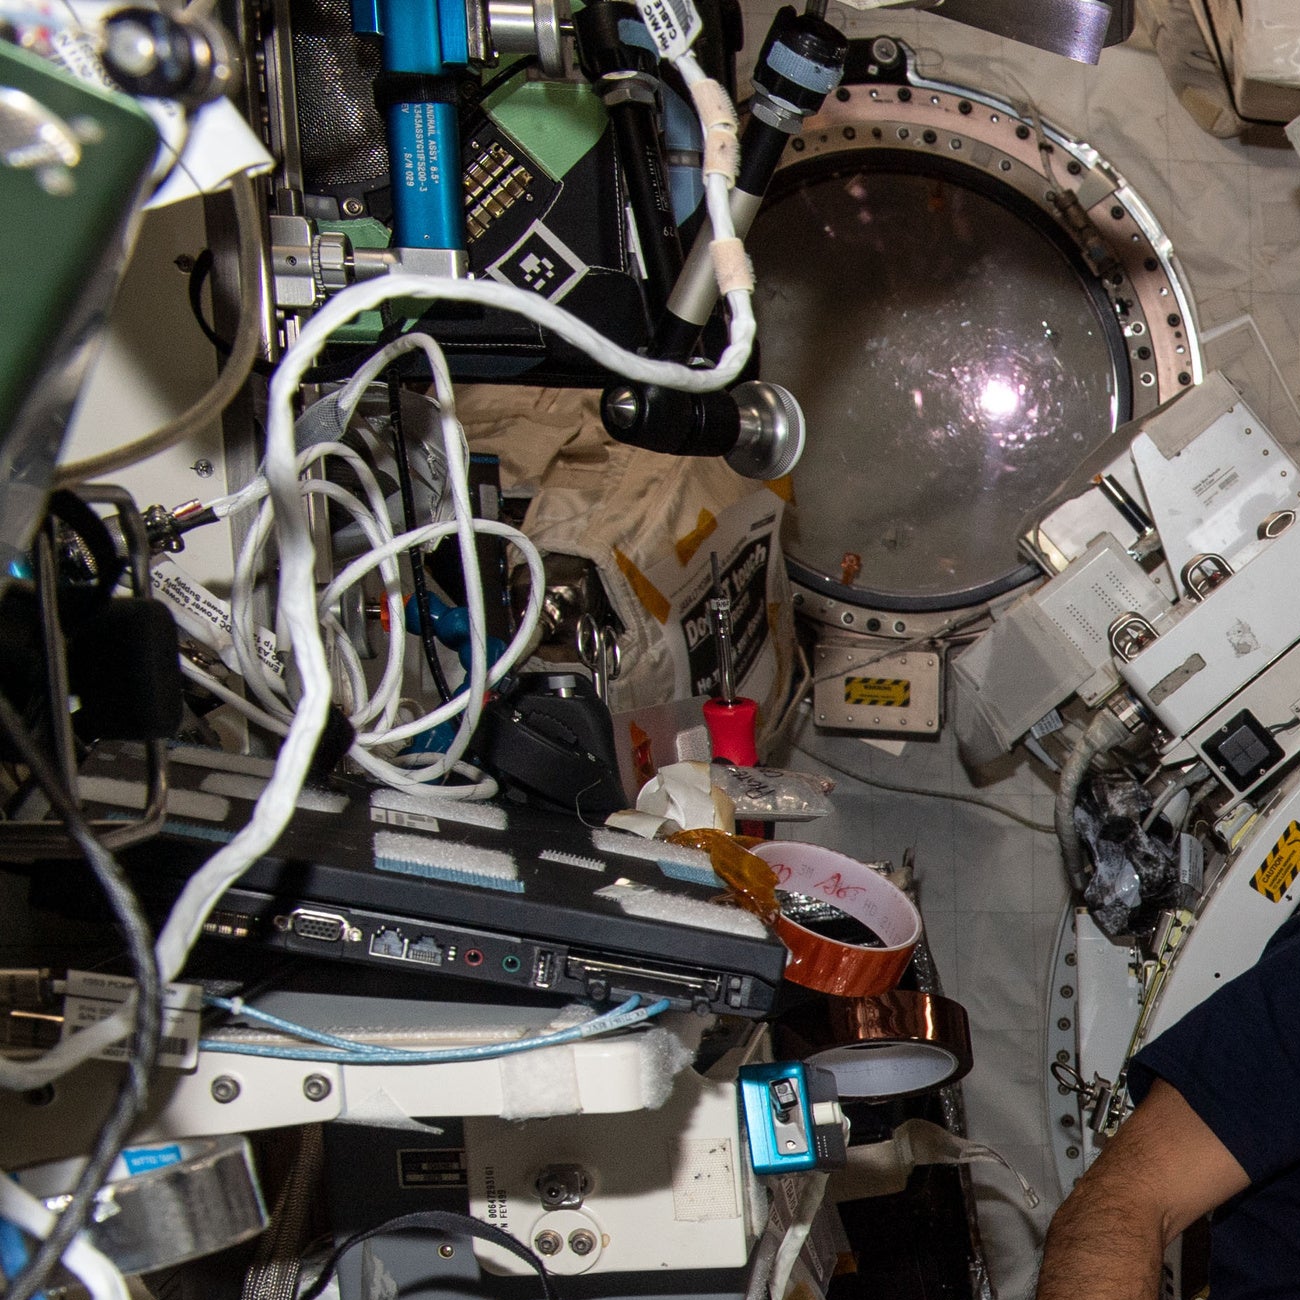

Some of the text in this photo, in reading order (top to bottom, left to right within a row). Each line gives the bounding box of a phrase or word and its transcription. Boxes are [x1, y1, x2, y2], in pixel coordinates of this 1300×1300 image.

[644, 5, 662, 32] MIC
[401, 103, 410, 114] EV
[426, 103, 437, 136] ANDRAIL
[164, 577, 191, 604] Supply
[174, 576, 230, 621] Power Supply
[191, 601, 219, 624] Power
[1262, 855, 1285, 884] CAUTION
